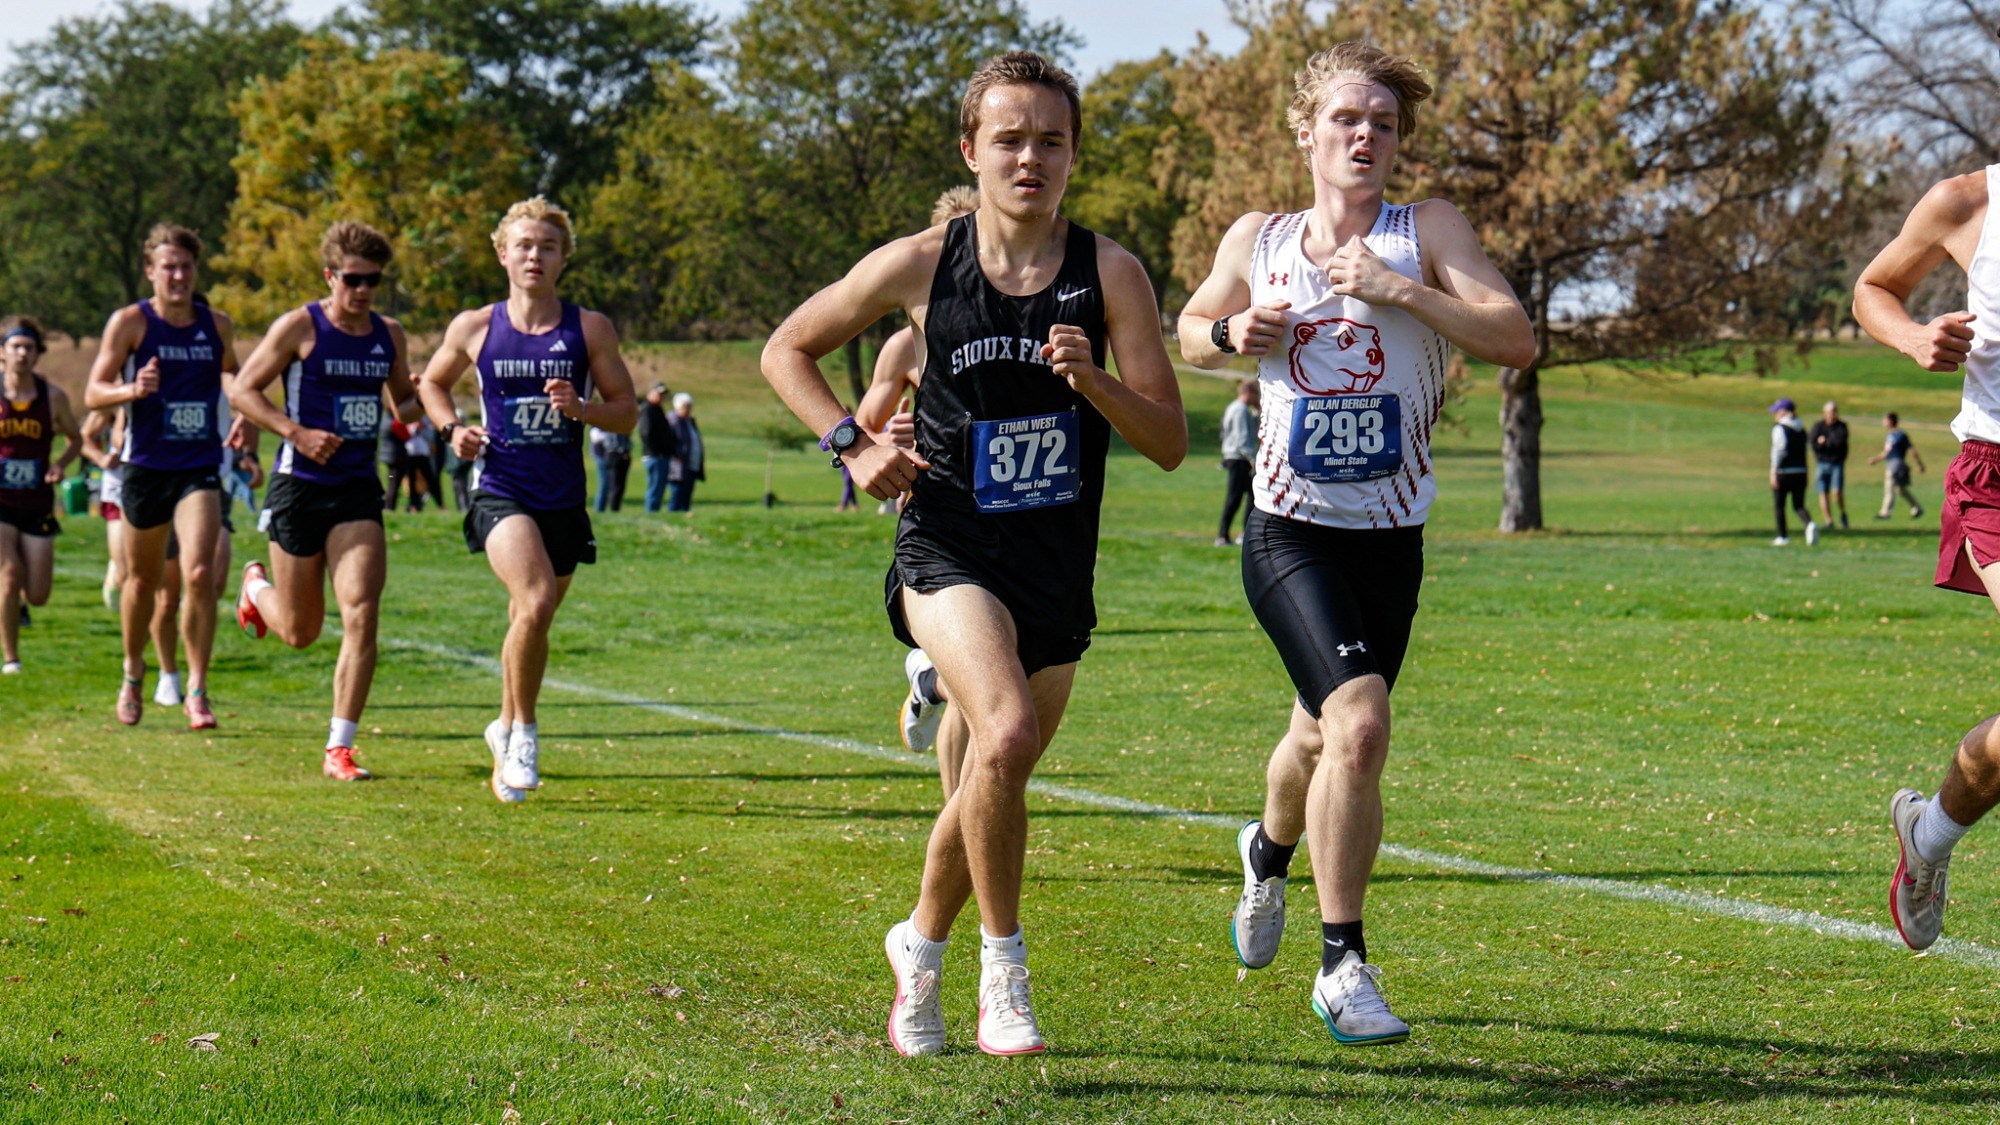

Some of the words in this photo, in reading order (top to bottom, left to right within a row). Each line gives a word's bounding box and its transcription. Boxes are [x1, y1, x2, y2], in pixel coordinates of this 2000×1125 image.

[951, 336, 1013, 375] SIOUX
[324, 359, 361, 376] WINONA
[364, 360, 390, 377] STATE
[493, 359, 536, 378] WINONA
[539, 359, 573, 378] STATE
[342, 402, 378, 426] 469
[1307, 399, 1339, 411] NOLAN
[1341, 398, 1382, 410] BERGLOF
[170, 408, 205, 429] 480
[512, 404, 561, 430] 474
[998, 420, 1029, 435] ETHAN
[1030, 416, 1058, 431] WEST
[1304, 410, 1385, 456] 293
[988, 429, 1068, 483] 372
[1323, 457, 1346, 467] Minot
[1347, 456, 1368, 466] State
[1012, 481, 1032, 492] Sioux
[1033, 479, 1051, 489] Falls
